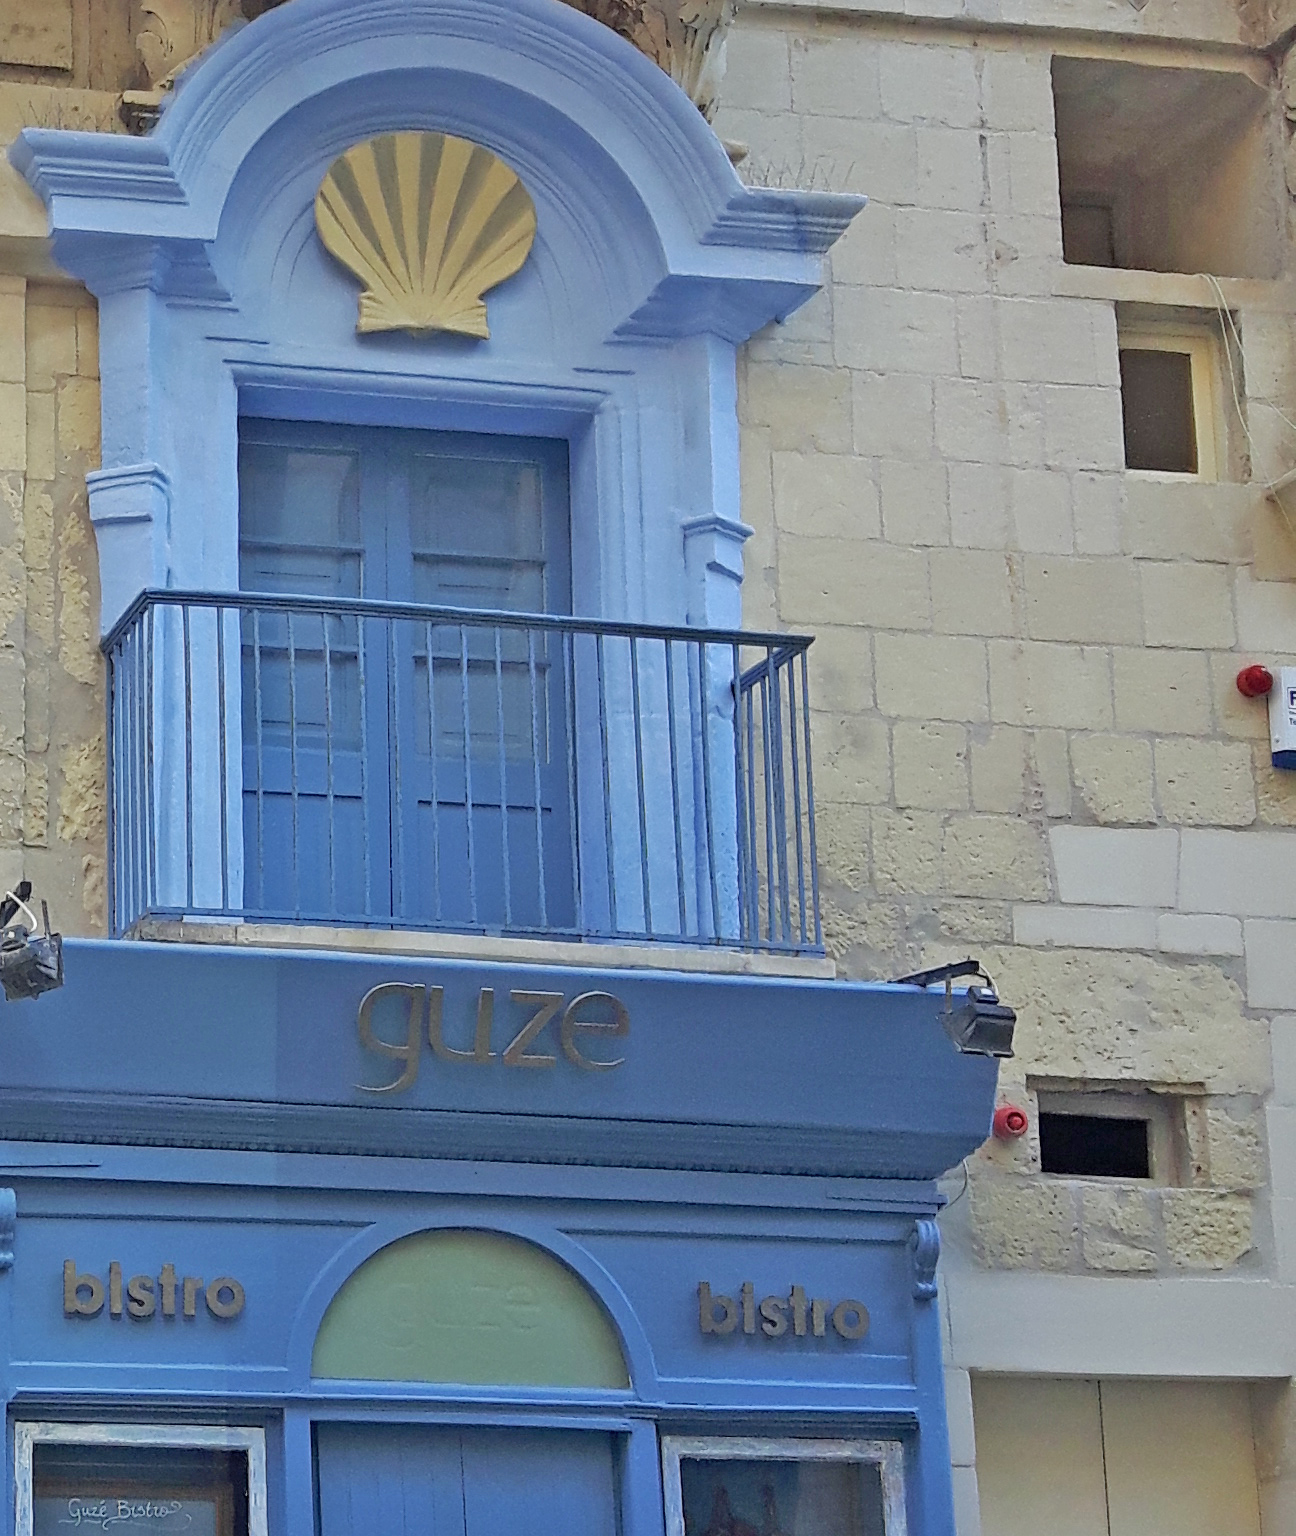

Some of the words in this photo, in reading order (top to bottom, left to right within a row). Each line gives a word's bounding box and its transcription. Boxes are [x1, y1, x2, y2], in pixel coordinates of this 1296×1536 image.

[353, 981, 630, 1094] guze
[63, 1259, 245, 1318] bistro
[698, 1280, 870, 1340] bistro
[102, 1500, 183, 1530] Bistro
